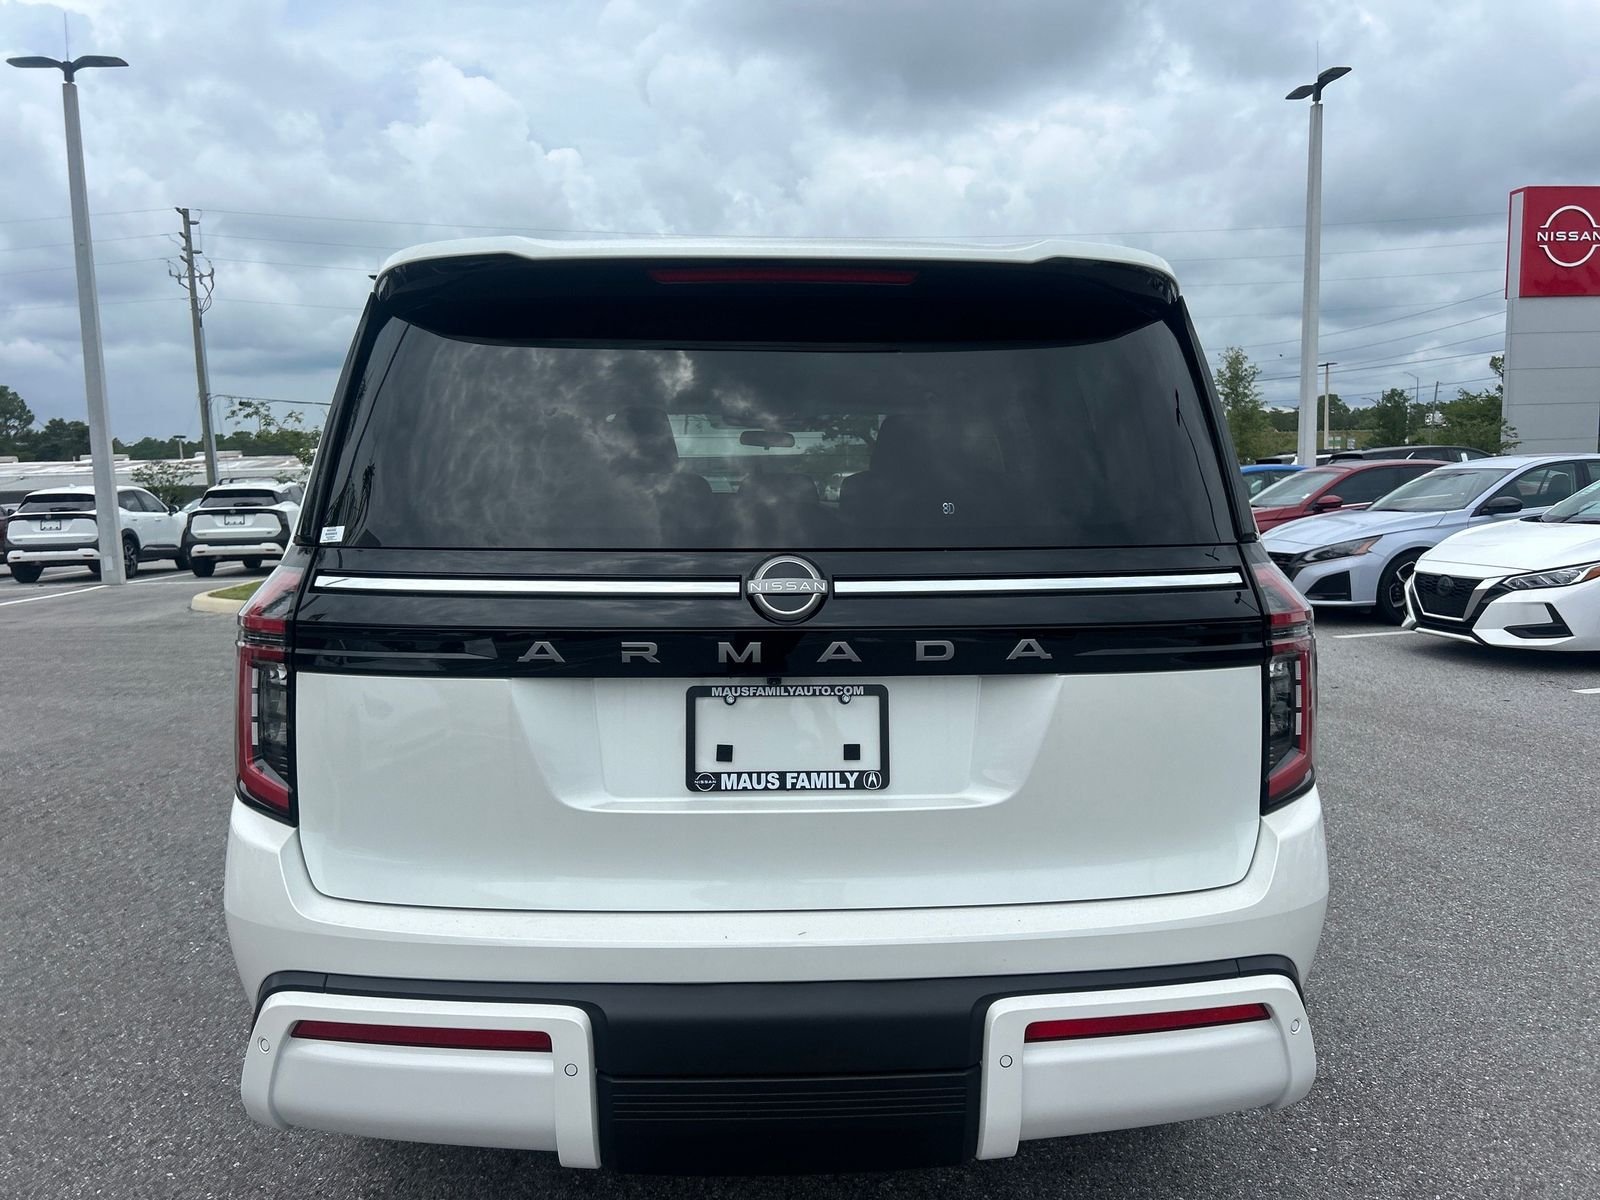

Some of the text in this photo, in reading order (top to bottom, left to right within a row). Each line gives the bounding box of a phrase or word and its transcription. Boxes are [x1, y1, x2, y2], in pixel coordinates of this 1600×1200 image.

[750, 581, 826, 592] NISSAN
[517, 638, 1052, 663] ARMADA
[711, 685, 865, 697] MAUSFAMILYAUTO.COM
[720, 772, 860, 790] MAUS FAMILY
